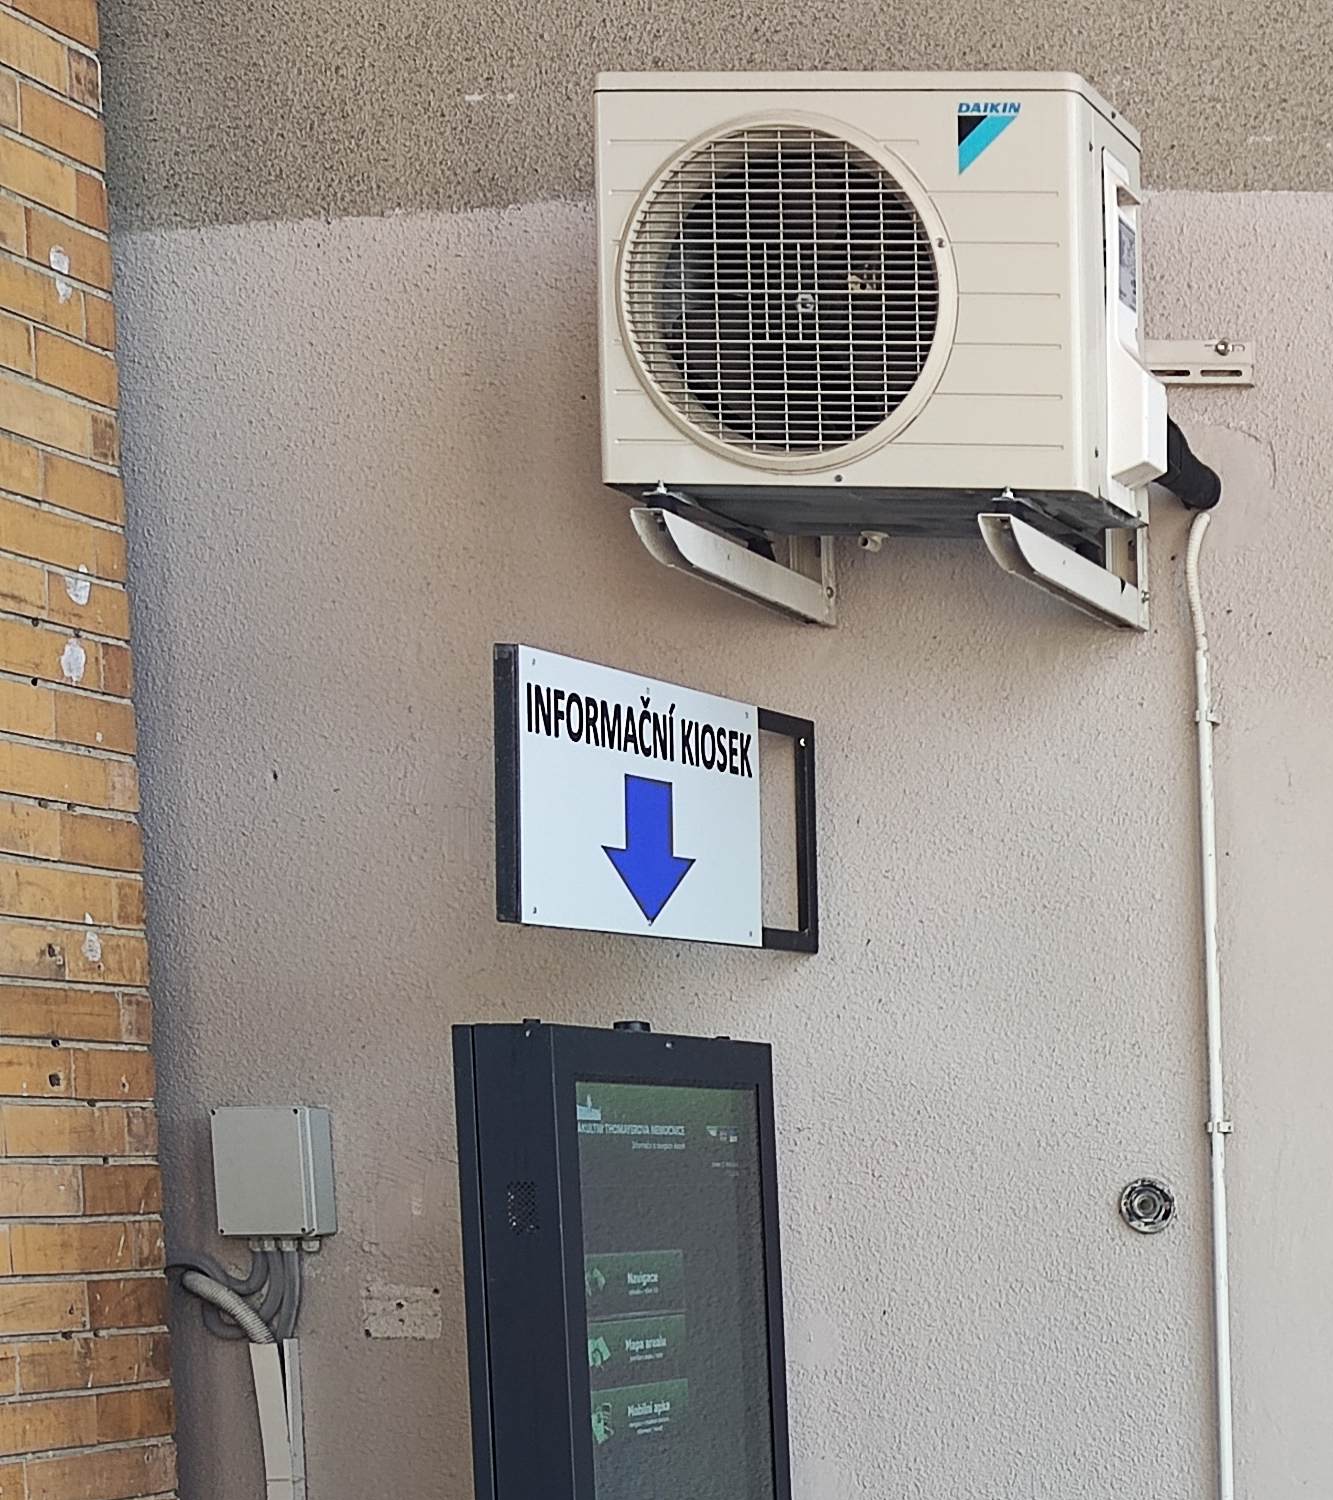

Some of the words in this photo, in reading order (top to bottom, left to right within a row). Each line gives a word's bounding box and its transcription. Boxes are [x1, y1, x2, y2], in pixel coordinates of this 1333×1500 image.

[957, 102, 1021, 113] DAIKIN
[526, 682, 676, 762] INFORMAČNÍ
[680, 718, 753, 778] KIOSEK
